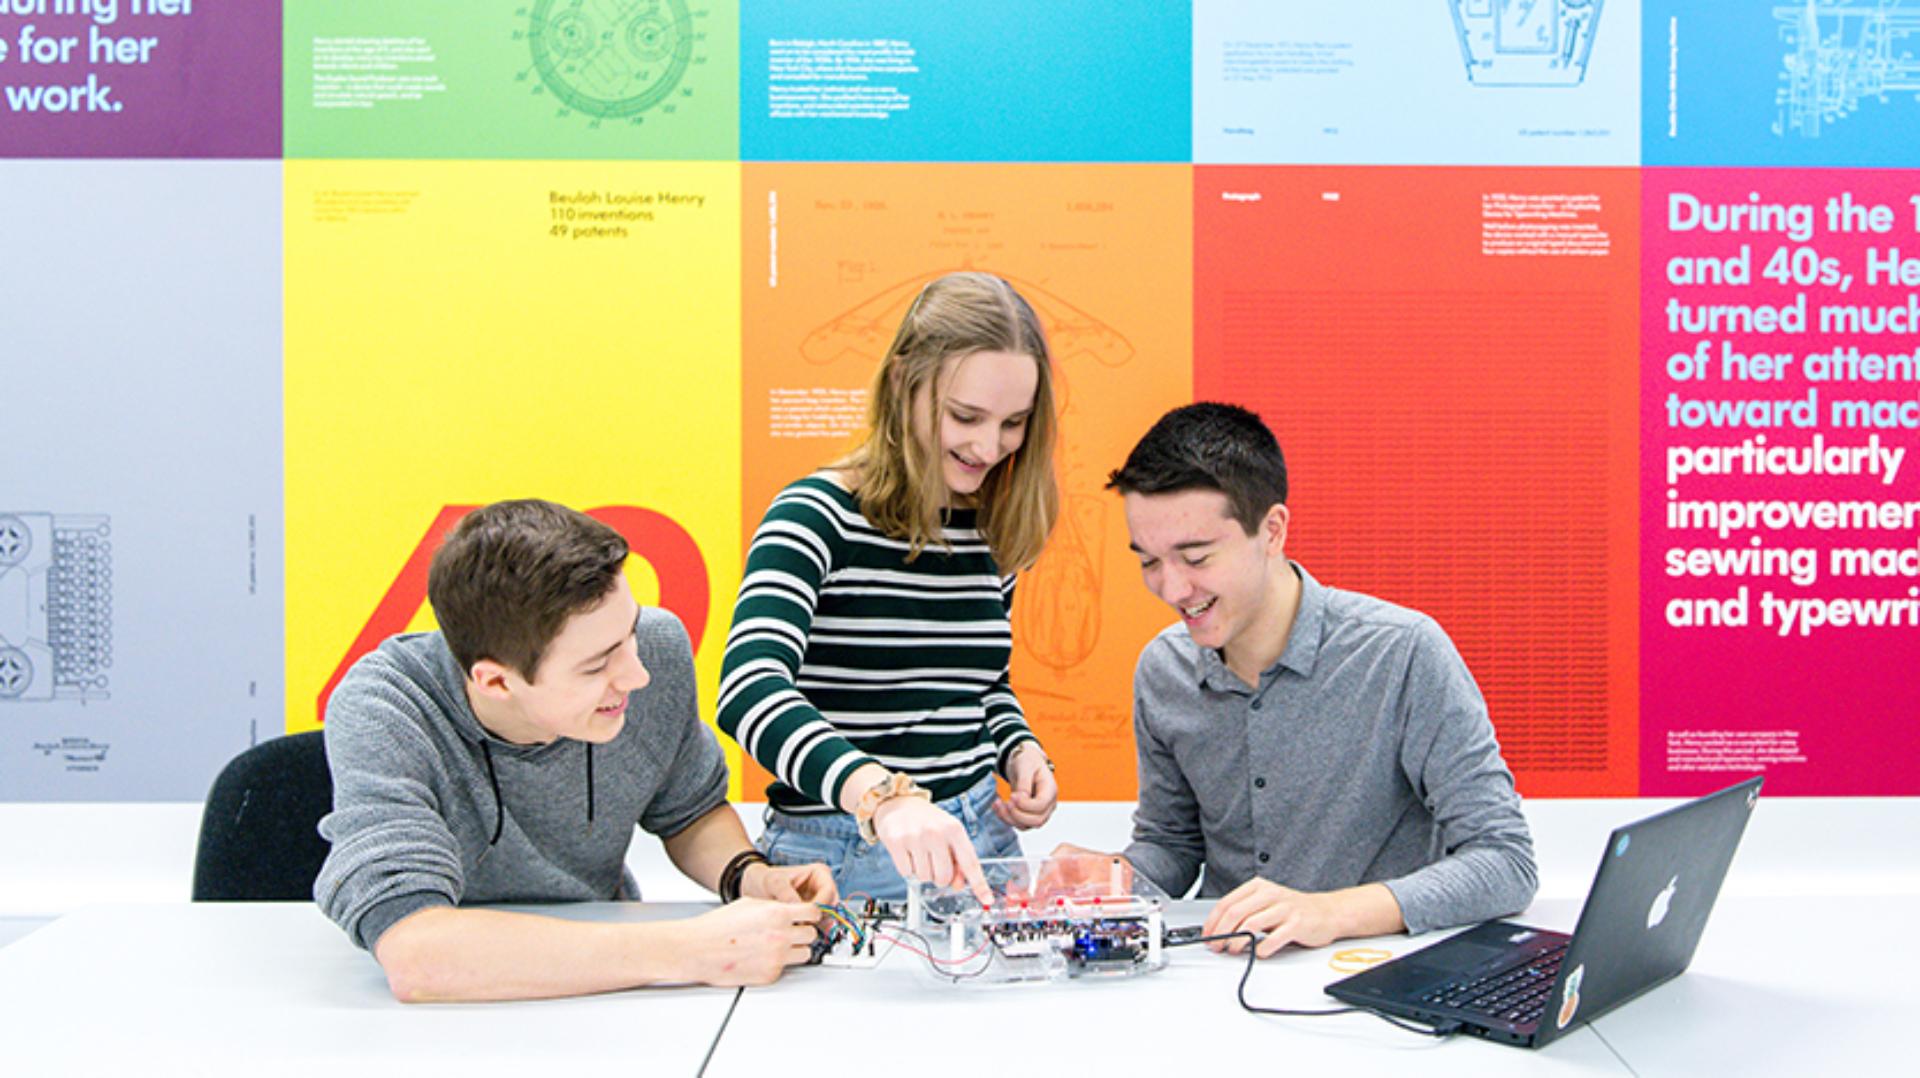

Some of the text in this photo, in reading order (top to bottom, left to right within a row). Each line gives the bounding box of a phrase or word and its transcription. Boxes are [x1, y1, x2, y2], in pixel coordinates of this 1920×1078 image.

[0, 0, 118, 24] urng
[18, 24, 79, 64] for
[89, 24, 159, 64] her
[5, 73, 124, 112] work.
[550, 191, 706, 208] Beulah Louise Henry
[551, 207, 655, 221] 110 inventions
[1668, 191, 1814, 242] During
[1824, 191, 1895, 234] the
[550, 225, 629, 240] 49 patents
[1666, 244, 1751, 286] and
[1762, 246, 1854, 293] 40s,
[1665, 292, 1806, 334] turned
[1666, 339, 1712, 382] of
[1721, 340, 1794, 382] her
[1665, 387, 1818, 428] toward
[1666, 433, 1906, 485] particularly
[1665, 535, 1818, 586] sewing
[1665, 585, 1749, 627] and
